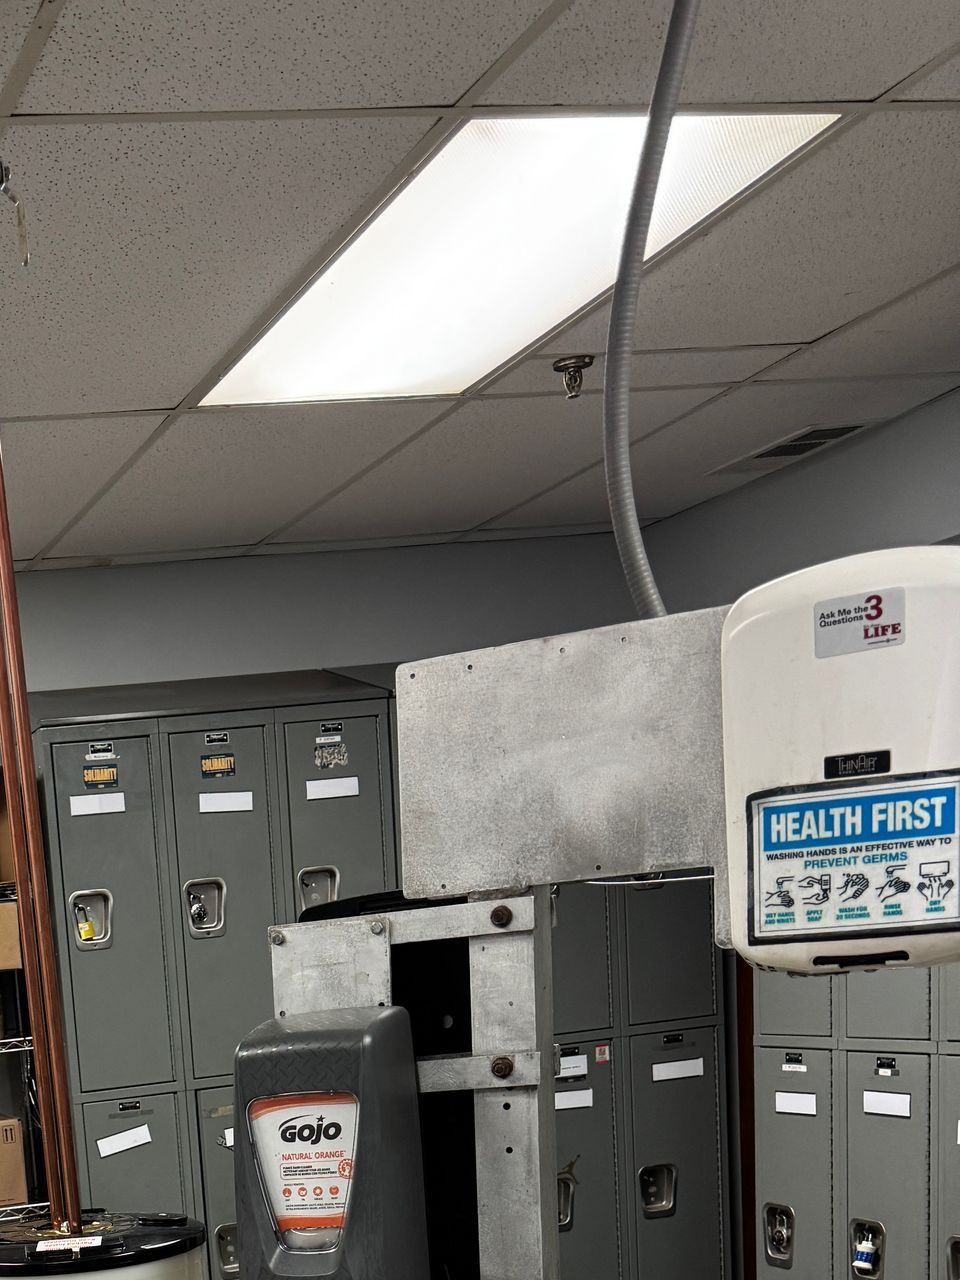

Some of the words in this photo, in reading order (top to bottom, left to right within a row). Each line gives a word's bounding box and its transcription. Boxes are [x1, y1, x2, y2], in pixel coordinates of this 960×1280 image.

[819, 611, 836, 620] Ask
[837, 608, 852, 617] Me
[853, 605, 869, 614] the
[864, 594, 883, 621] 3
[819, 614, 864, 628] Questions
[863, 622, 902, 640] LIFE
[770, 805, 863, 844] HEALTH
[871, 796, 947, 834] FIRST
[766, 851, 805, 861] WASHING
[806, 848, 837, 858] HANDS
[838, 847, 848, 855] IS
[849, 845, 863, 854] AN
[865, 840, 915, 852] EFFECTIVE
[916, 838, 937, 848] WAY
[939, 836, 952, 845] TO
[803, 856, 859, 870] PREVENT
[862, 851, 908, 865] GERMS
[280, 1115, 342, 1145] GOJO
[281, 1152, 313, 1161] NATURAL
[314, 1150, 345, 1160] ORANGE
